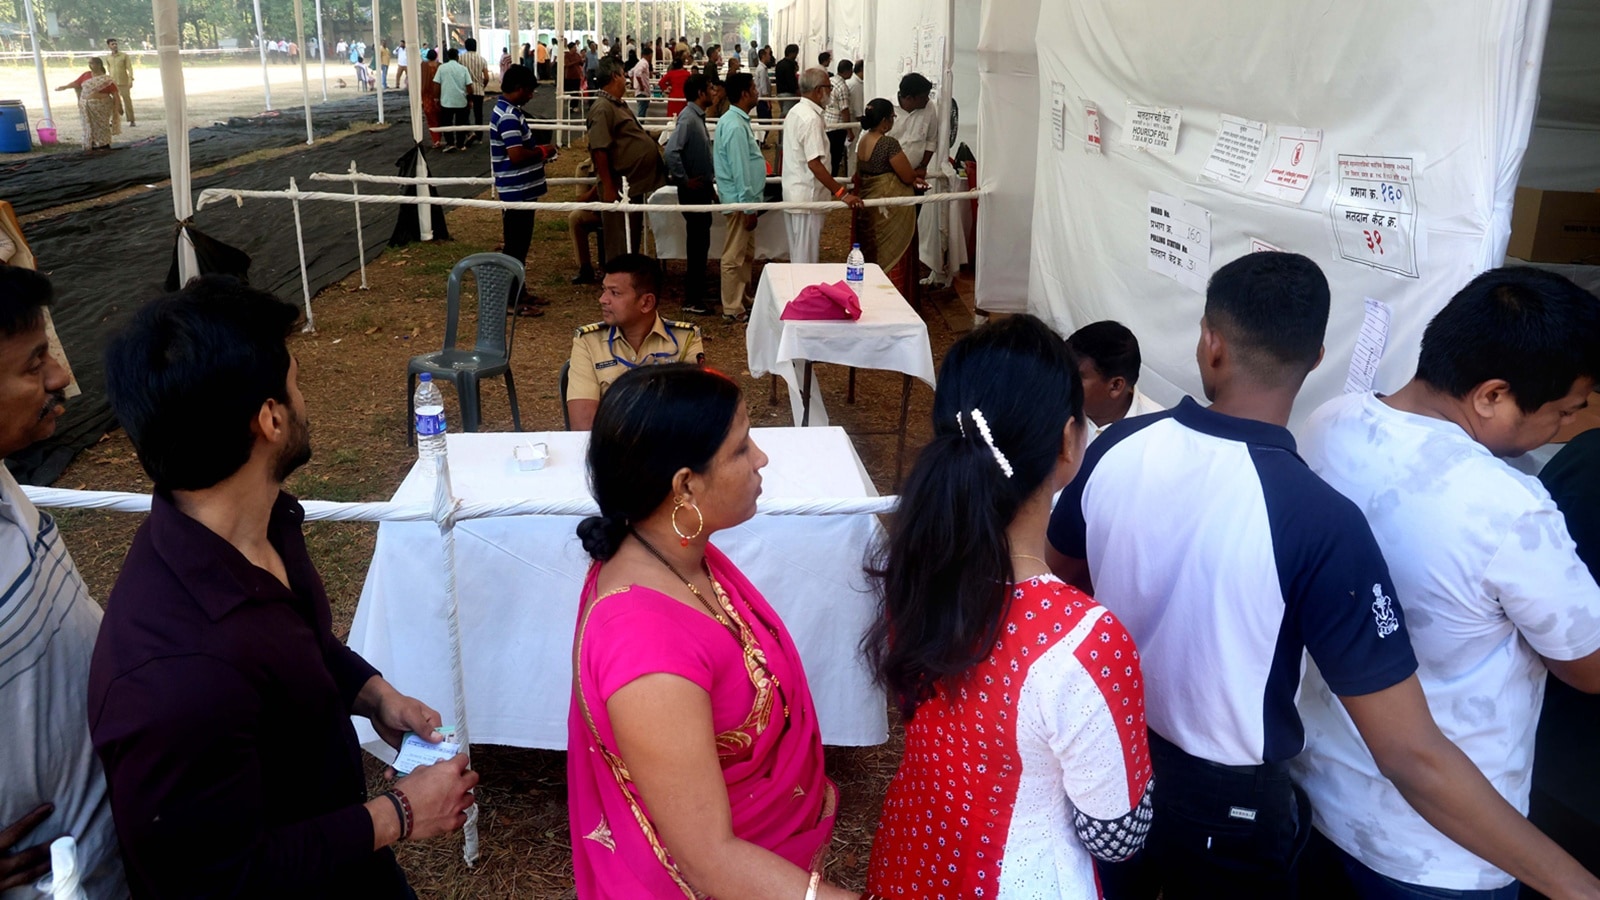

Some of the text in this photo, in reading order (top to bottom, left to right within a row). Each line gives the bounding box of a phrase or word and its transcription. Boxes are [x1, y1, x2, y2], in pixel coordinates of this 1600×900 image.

[1158, 130, 1169, 141] POLL
[1350, 187, 1367, 199] प्रभाग
[1381, 182, 1403, 204] १६०
[1151, 206, 1162, 216] WARD
[1345, 210, 1369, 223] मतदान
[1150, 220, 1165, 231] प्रभाग
[1187, 227, 1202, 243] 160
[1150, 233, 1166, 245] POLLING
[1167, 239, 1181, 250] STATION
[1363, 229, 1384, 255] ३१
[1150, 247, 1166, 260] मतदान
